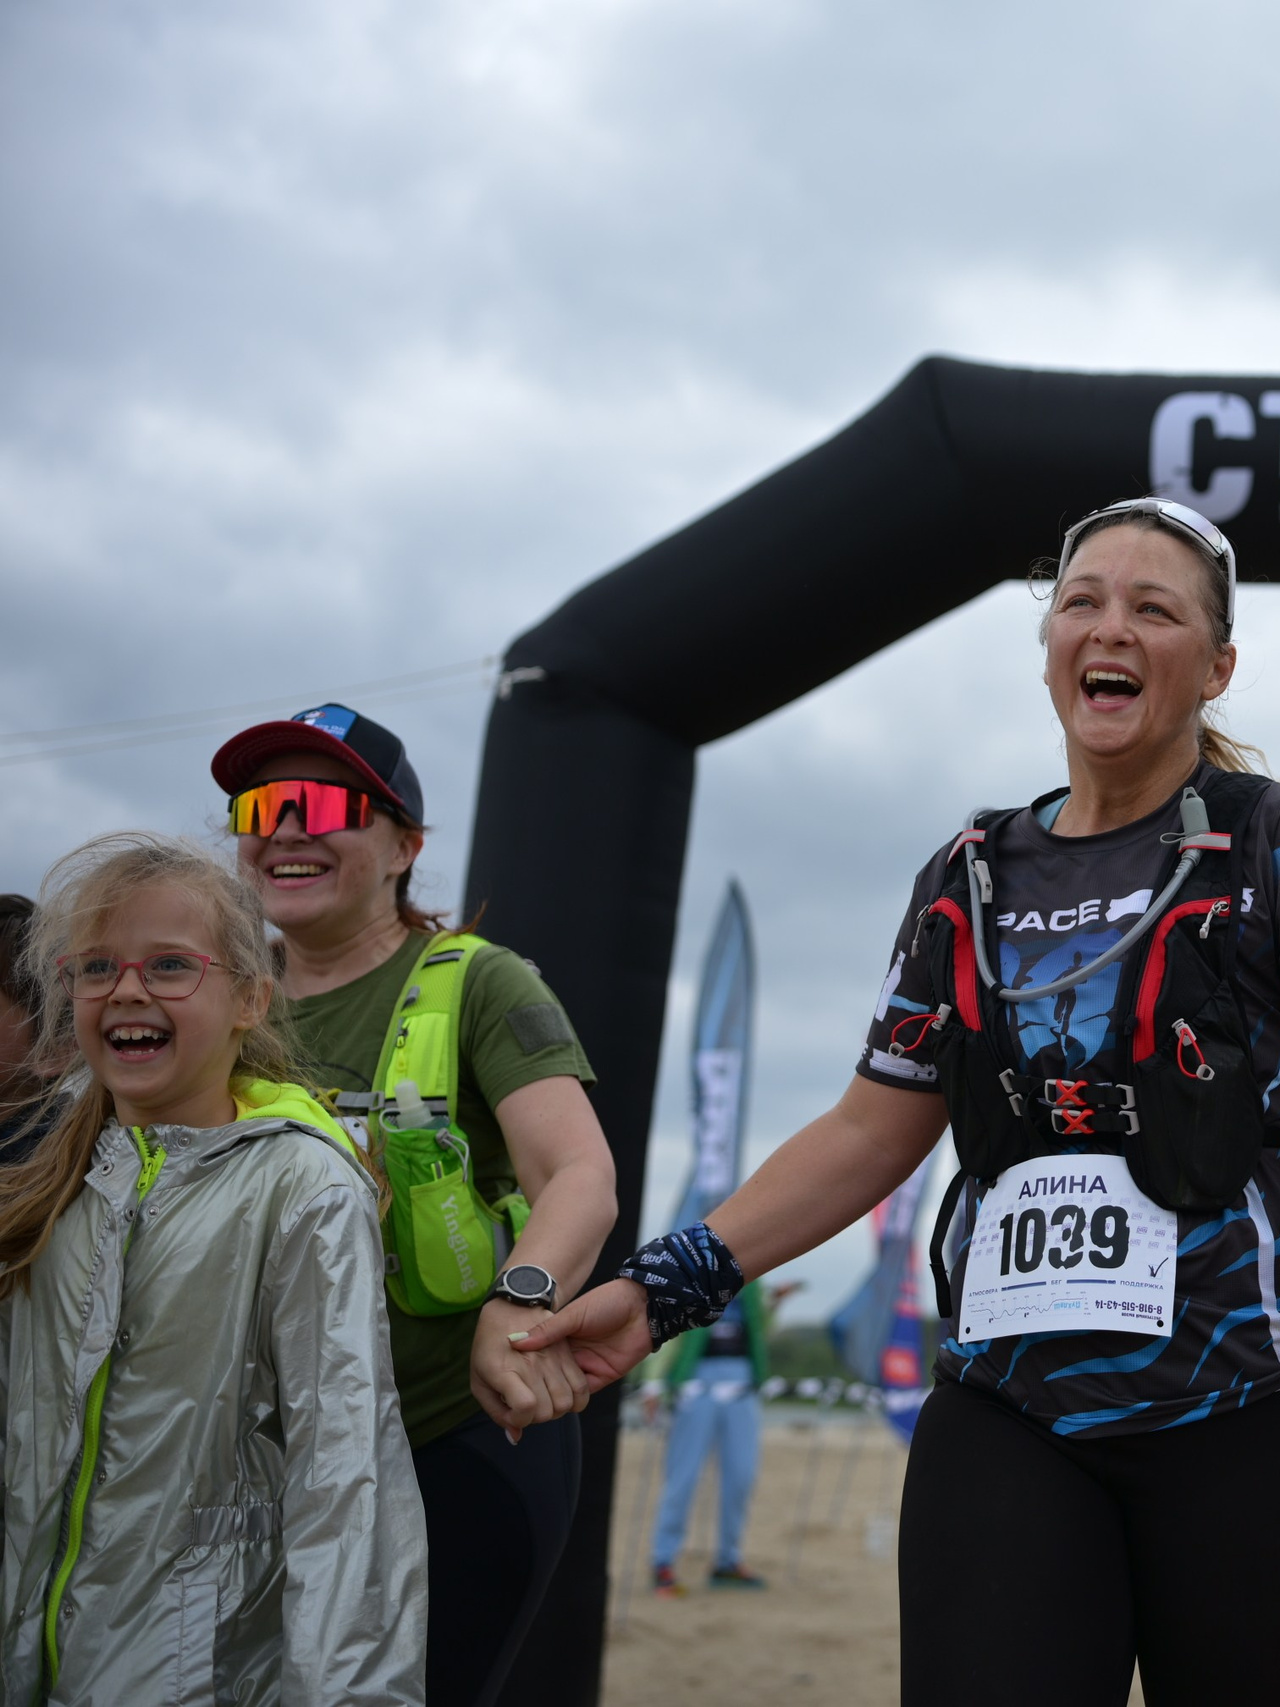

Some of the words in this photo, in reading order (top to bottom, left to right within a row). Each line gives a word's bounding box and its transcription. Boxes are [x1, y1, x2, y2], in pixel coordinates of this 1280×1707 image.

[1018, 1175, 1107, 1200] АЛИНА
[441, 1194, 478, 1295] Yinglang
[1000, 1205, 1130, 1276] 1039
[968, 1288, 998, 1298] АТМОСФЕРА
[1120, 1280, 1164, 1290] ПОДДЕРЖКА
[1095, 1299, 1163, 1315] 8-918-515-43-14
